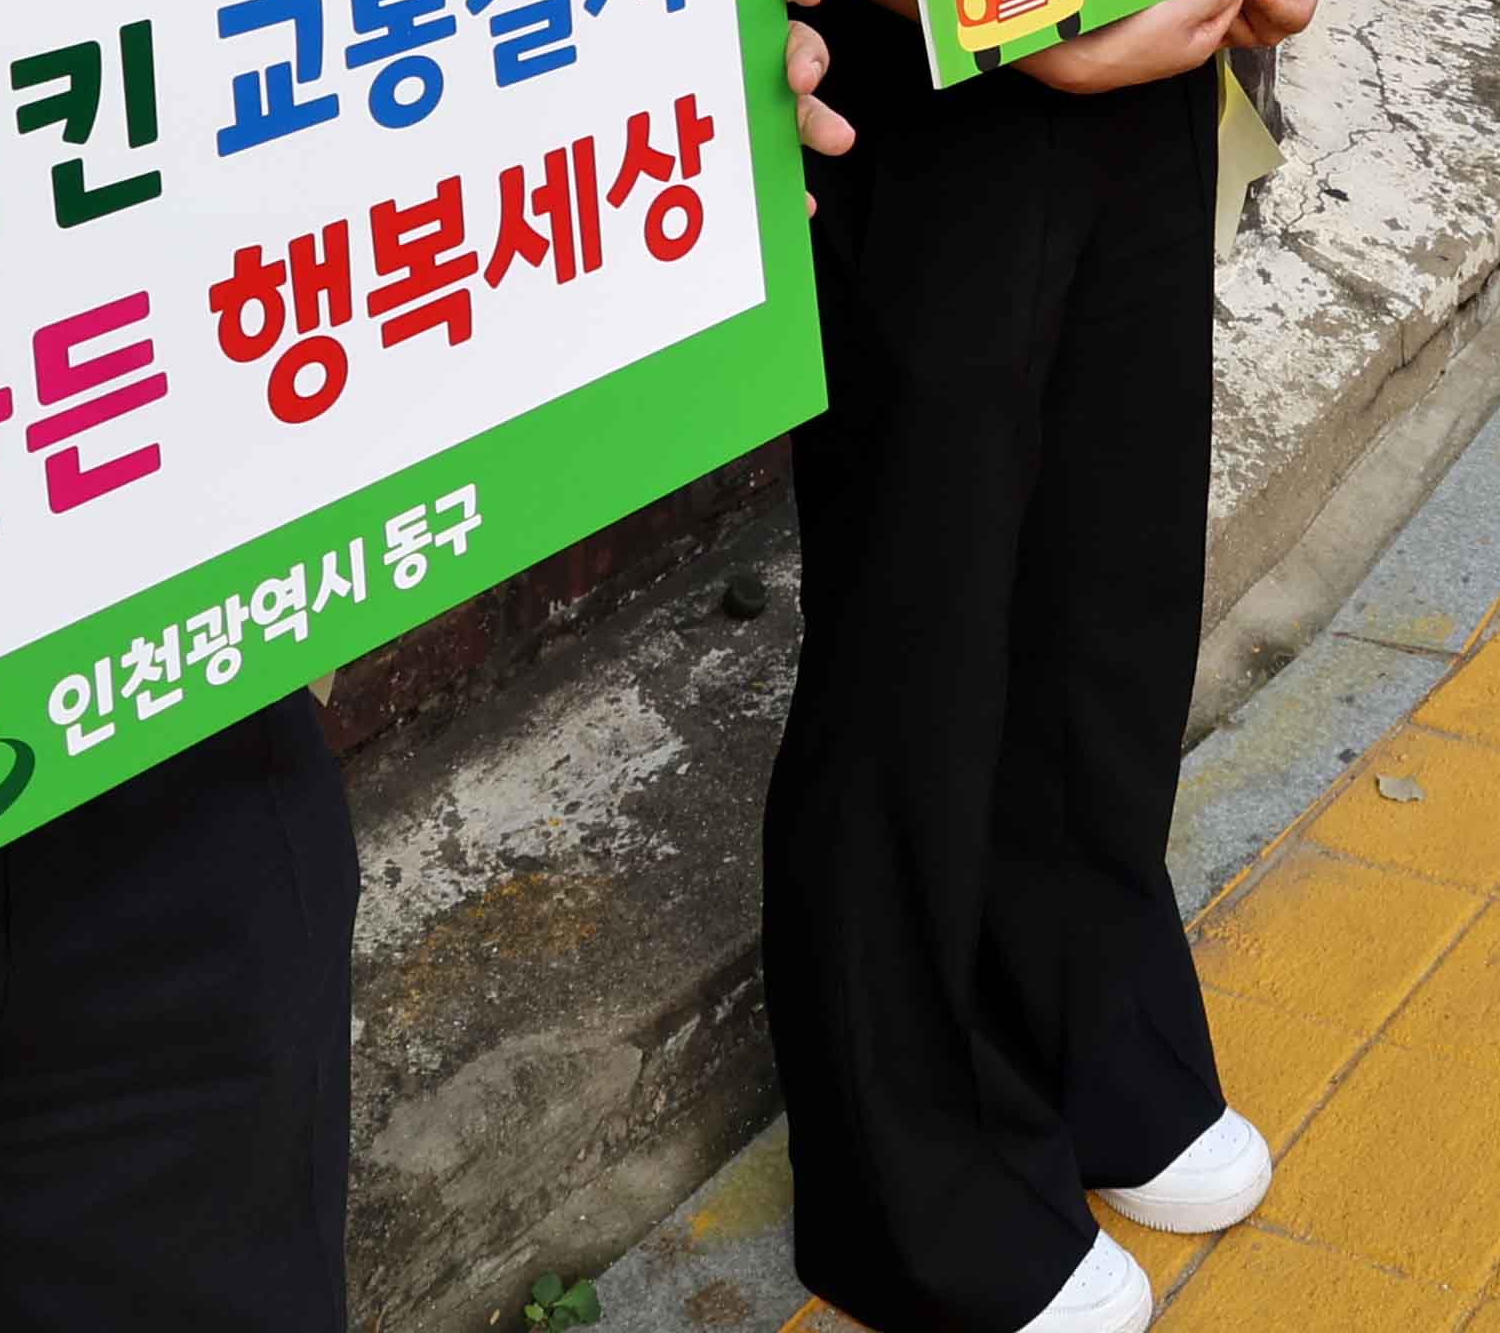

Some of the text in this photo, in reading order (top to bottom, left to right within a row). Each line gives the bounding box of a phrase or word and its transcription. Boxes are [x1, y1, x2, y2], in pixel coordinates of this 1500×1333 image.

[208, 95, 714, 425] 행복세상
[48, 483, 486, 754] 인천광역시 동구
